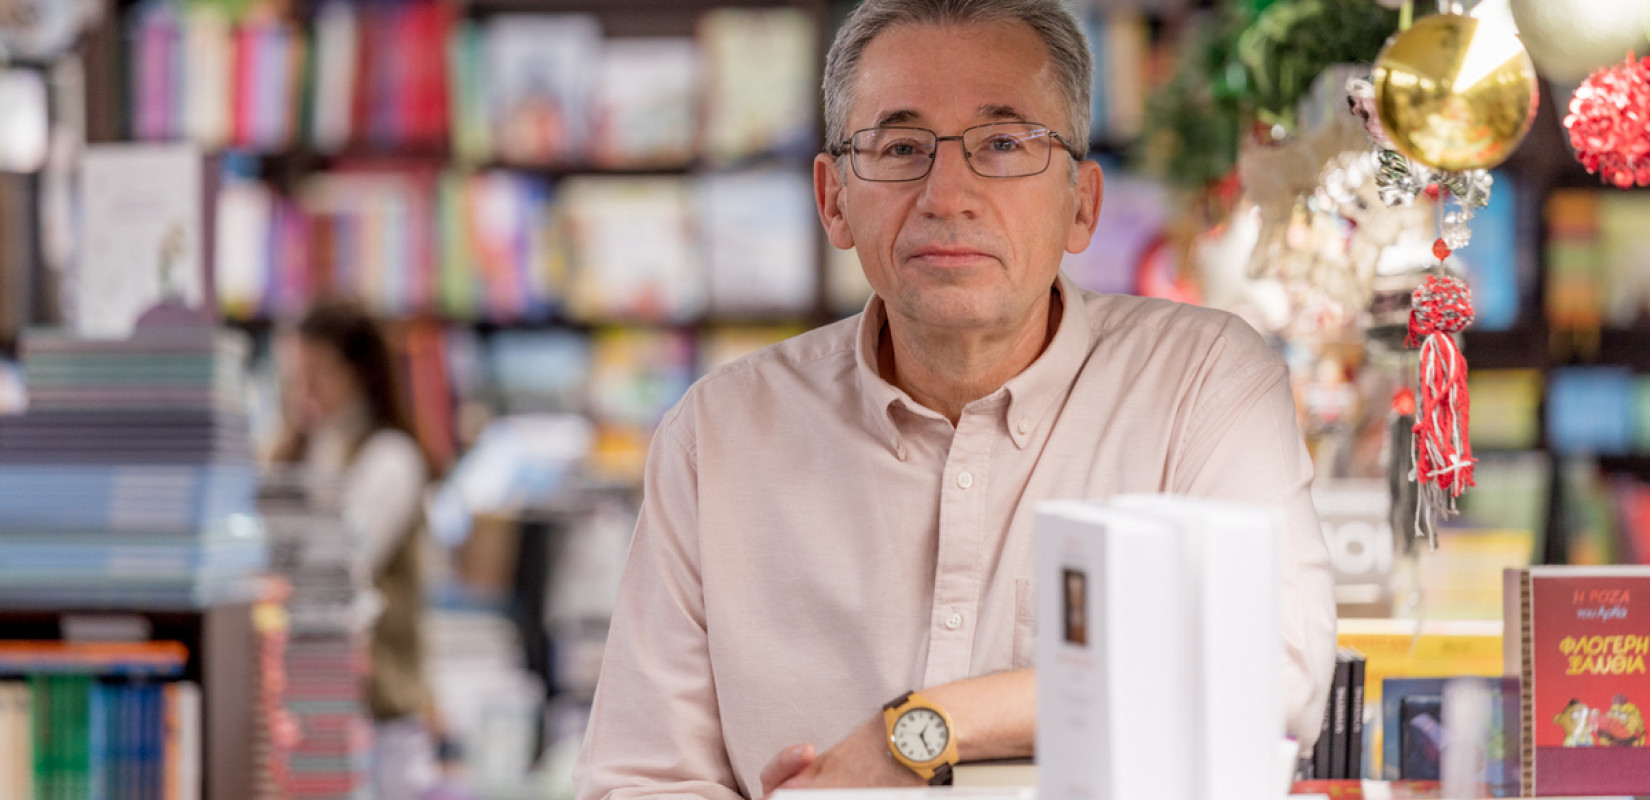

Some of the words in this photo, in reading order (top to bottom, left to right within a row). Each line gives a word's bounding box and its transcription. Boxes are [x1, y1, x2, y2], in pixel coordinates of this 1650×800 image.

[1589, 589, 1630, 604] ΡΟΖΑ
[1559, 635, 1649, 656] ΦΛΟΓΕΡΗ
[1566, 656, 1646, 675] ΞΑΝΘΙΑ
